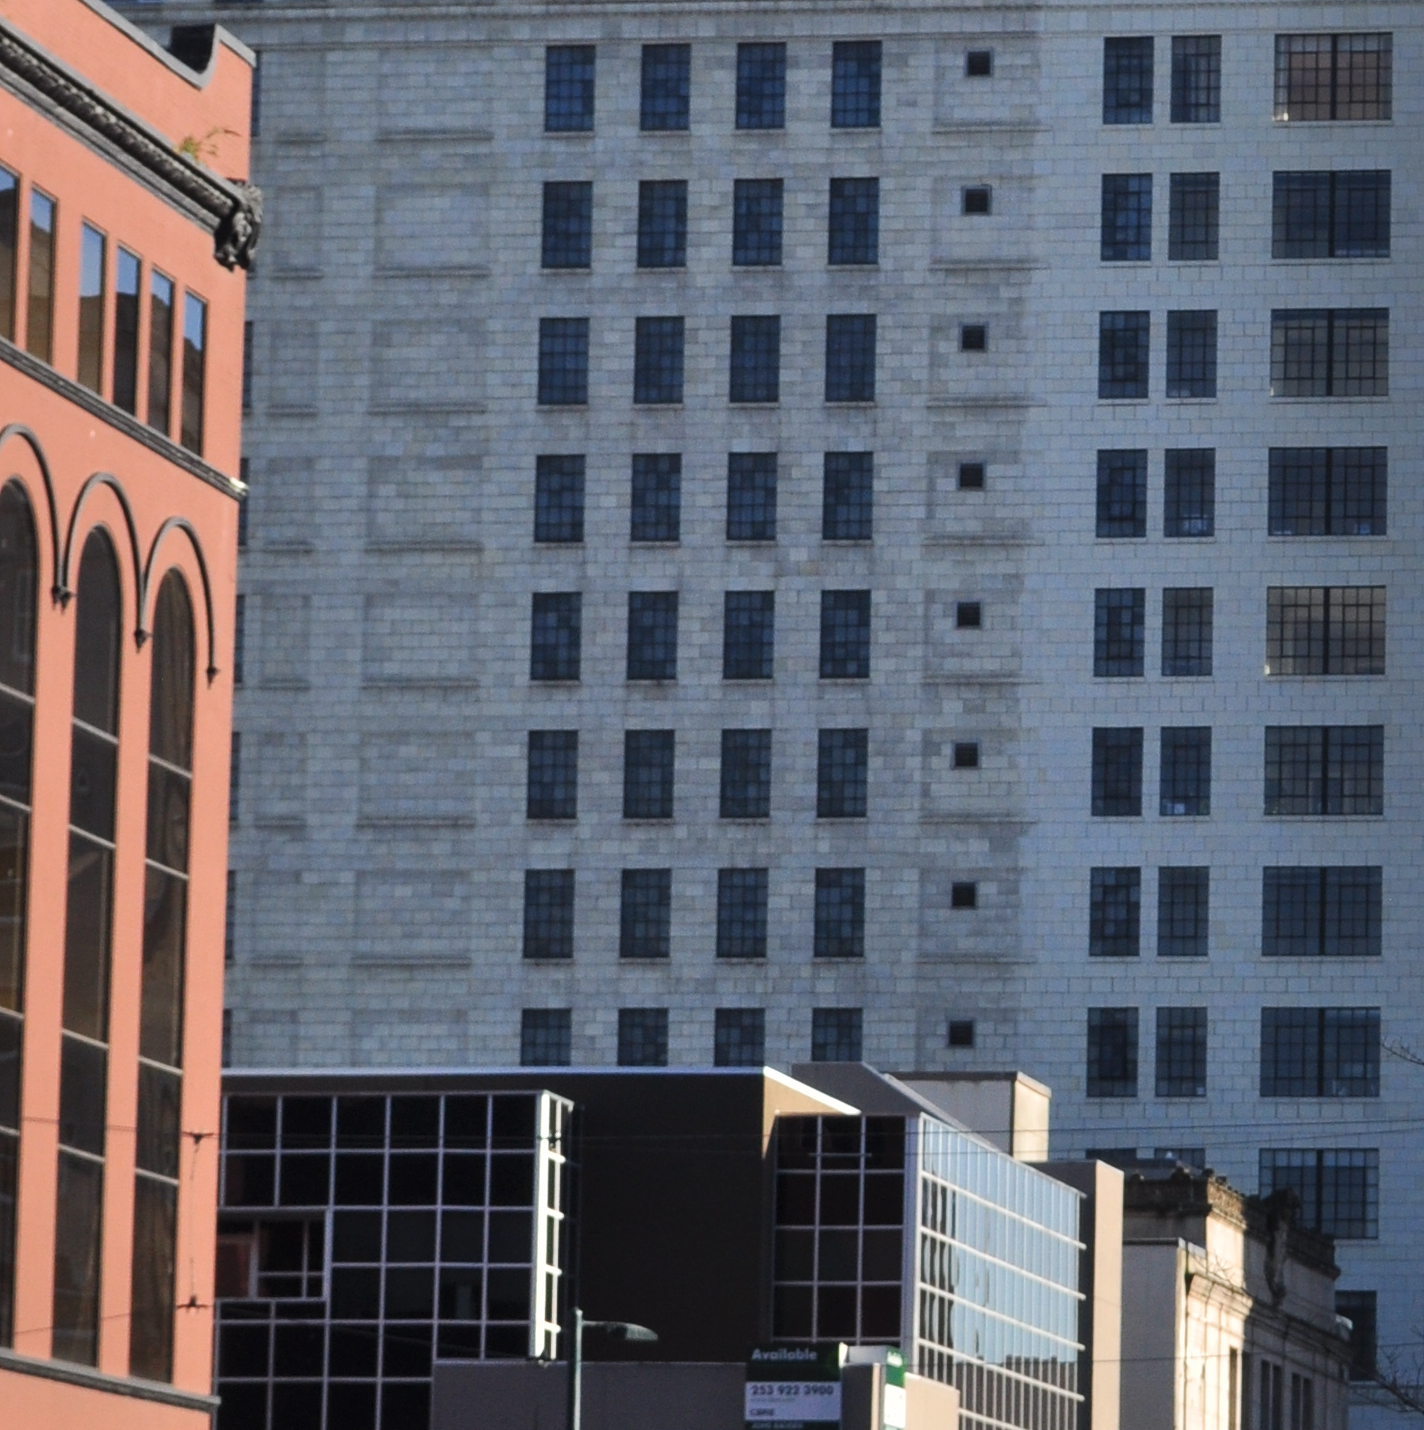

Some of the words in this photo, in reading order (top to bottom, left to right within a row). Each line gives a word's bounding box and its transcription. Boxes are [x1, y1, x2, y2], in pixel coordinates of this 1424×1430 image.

[751, 1347, 818, 1361] Available
[752, 1384, 774, 1396] 253
[777, 1384, 800, 1396] 922
[803, 1384, 835, 1396] 3900
